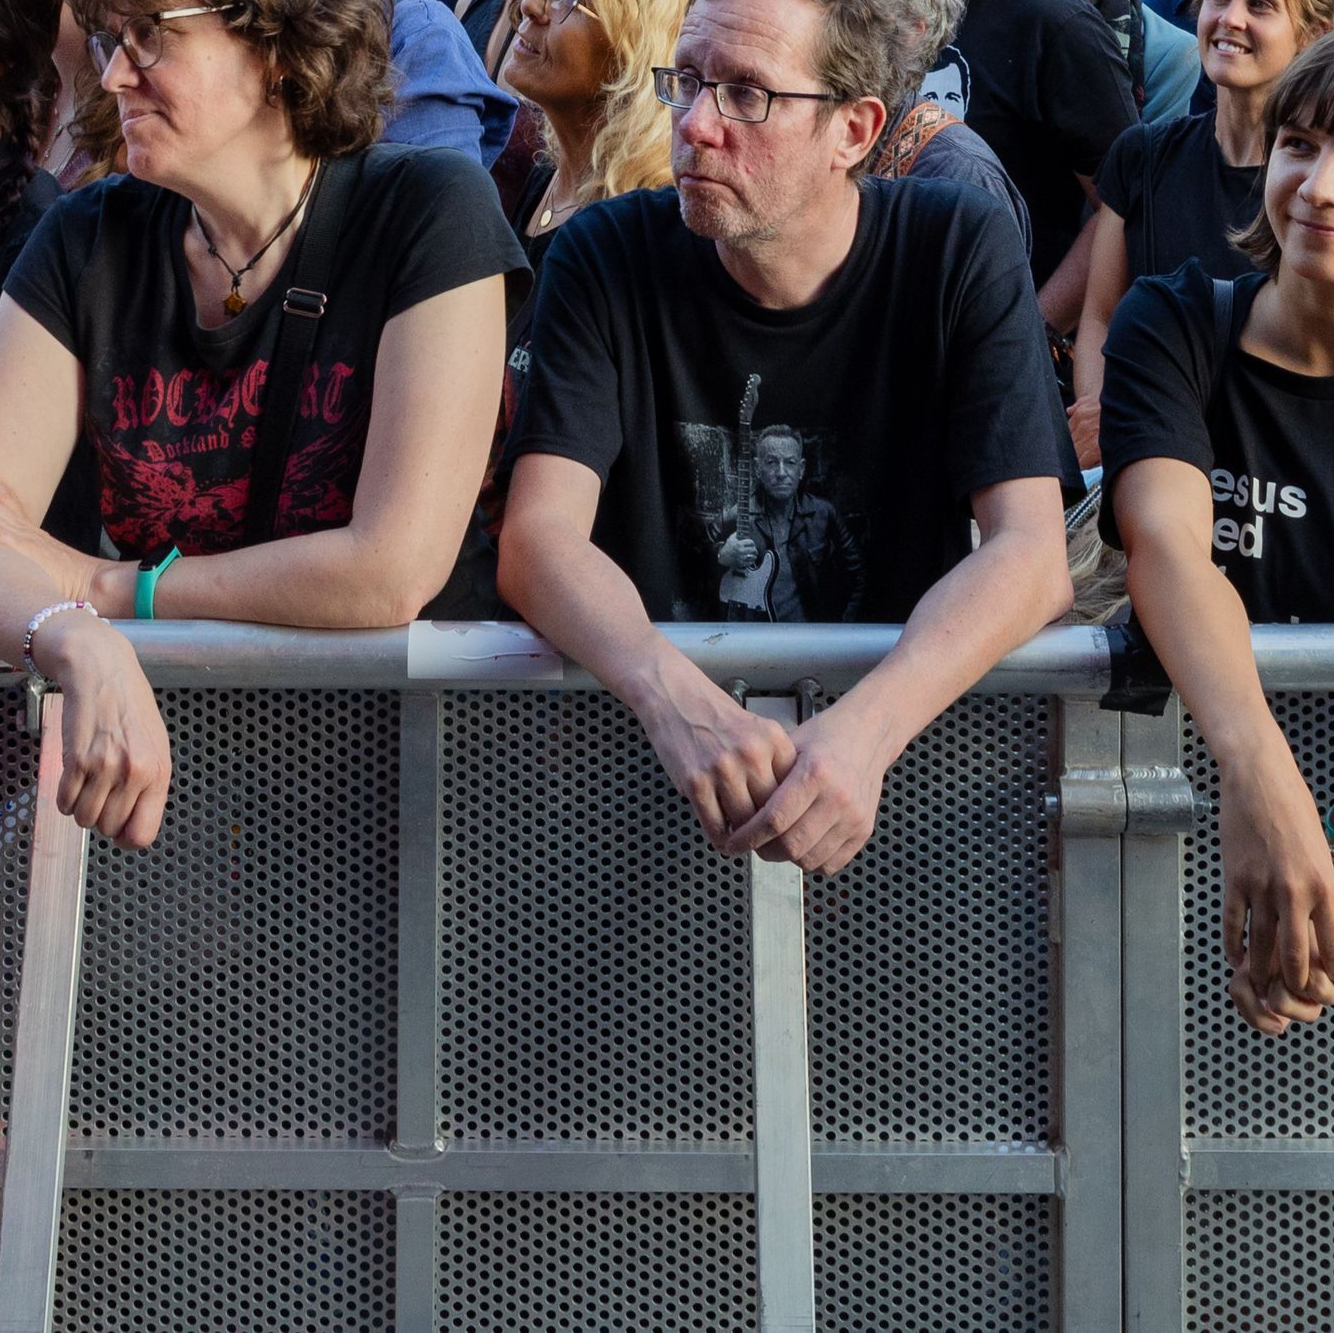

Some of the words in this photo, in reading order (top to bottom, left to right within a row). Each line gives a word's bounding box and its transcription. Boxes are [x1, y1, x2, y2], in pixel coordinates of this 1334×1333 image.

[111, 359, 355, 430] ROCKHERT
[1210, 468, 1307, 519] esus
[1213, 515, 1263, 559] ed
